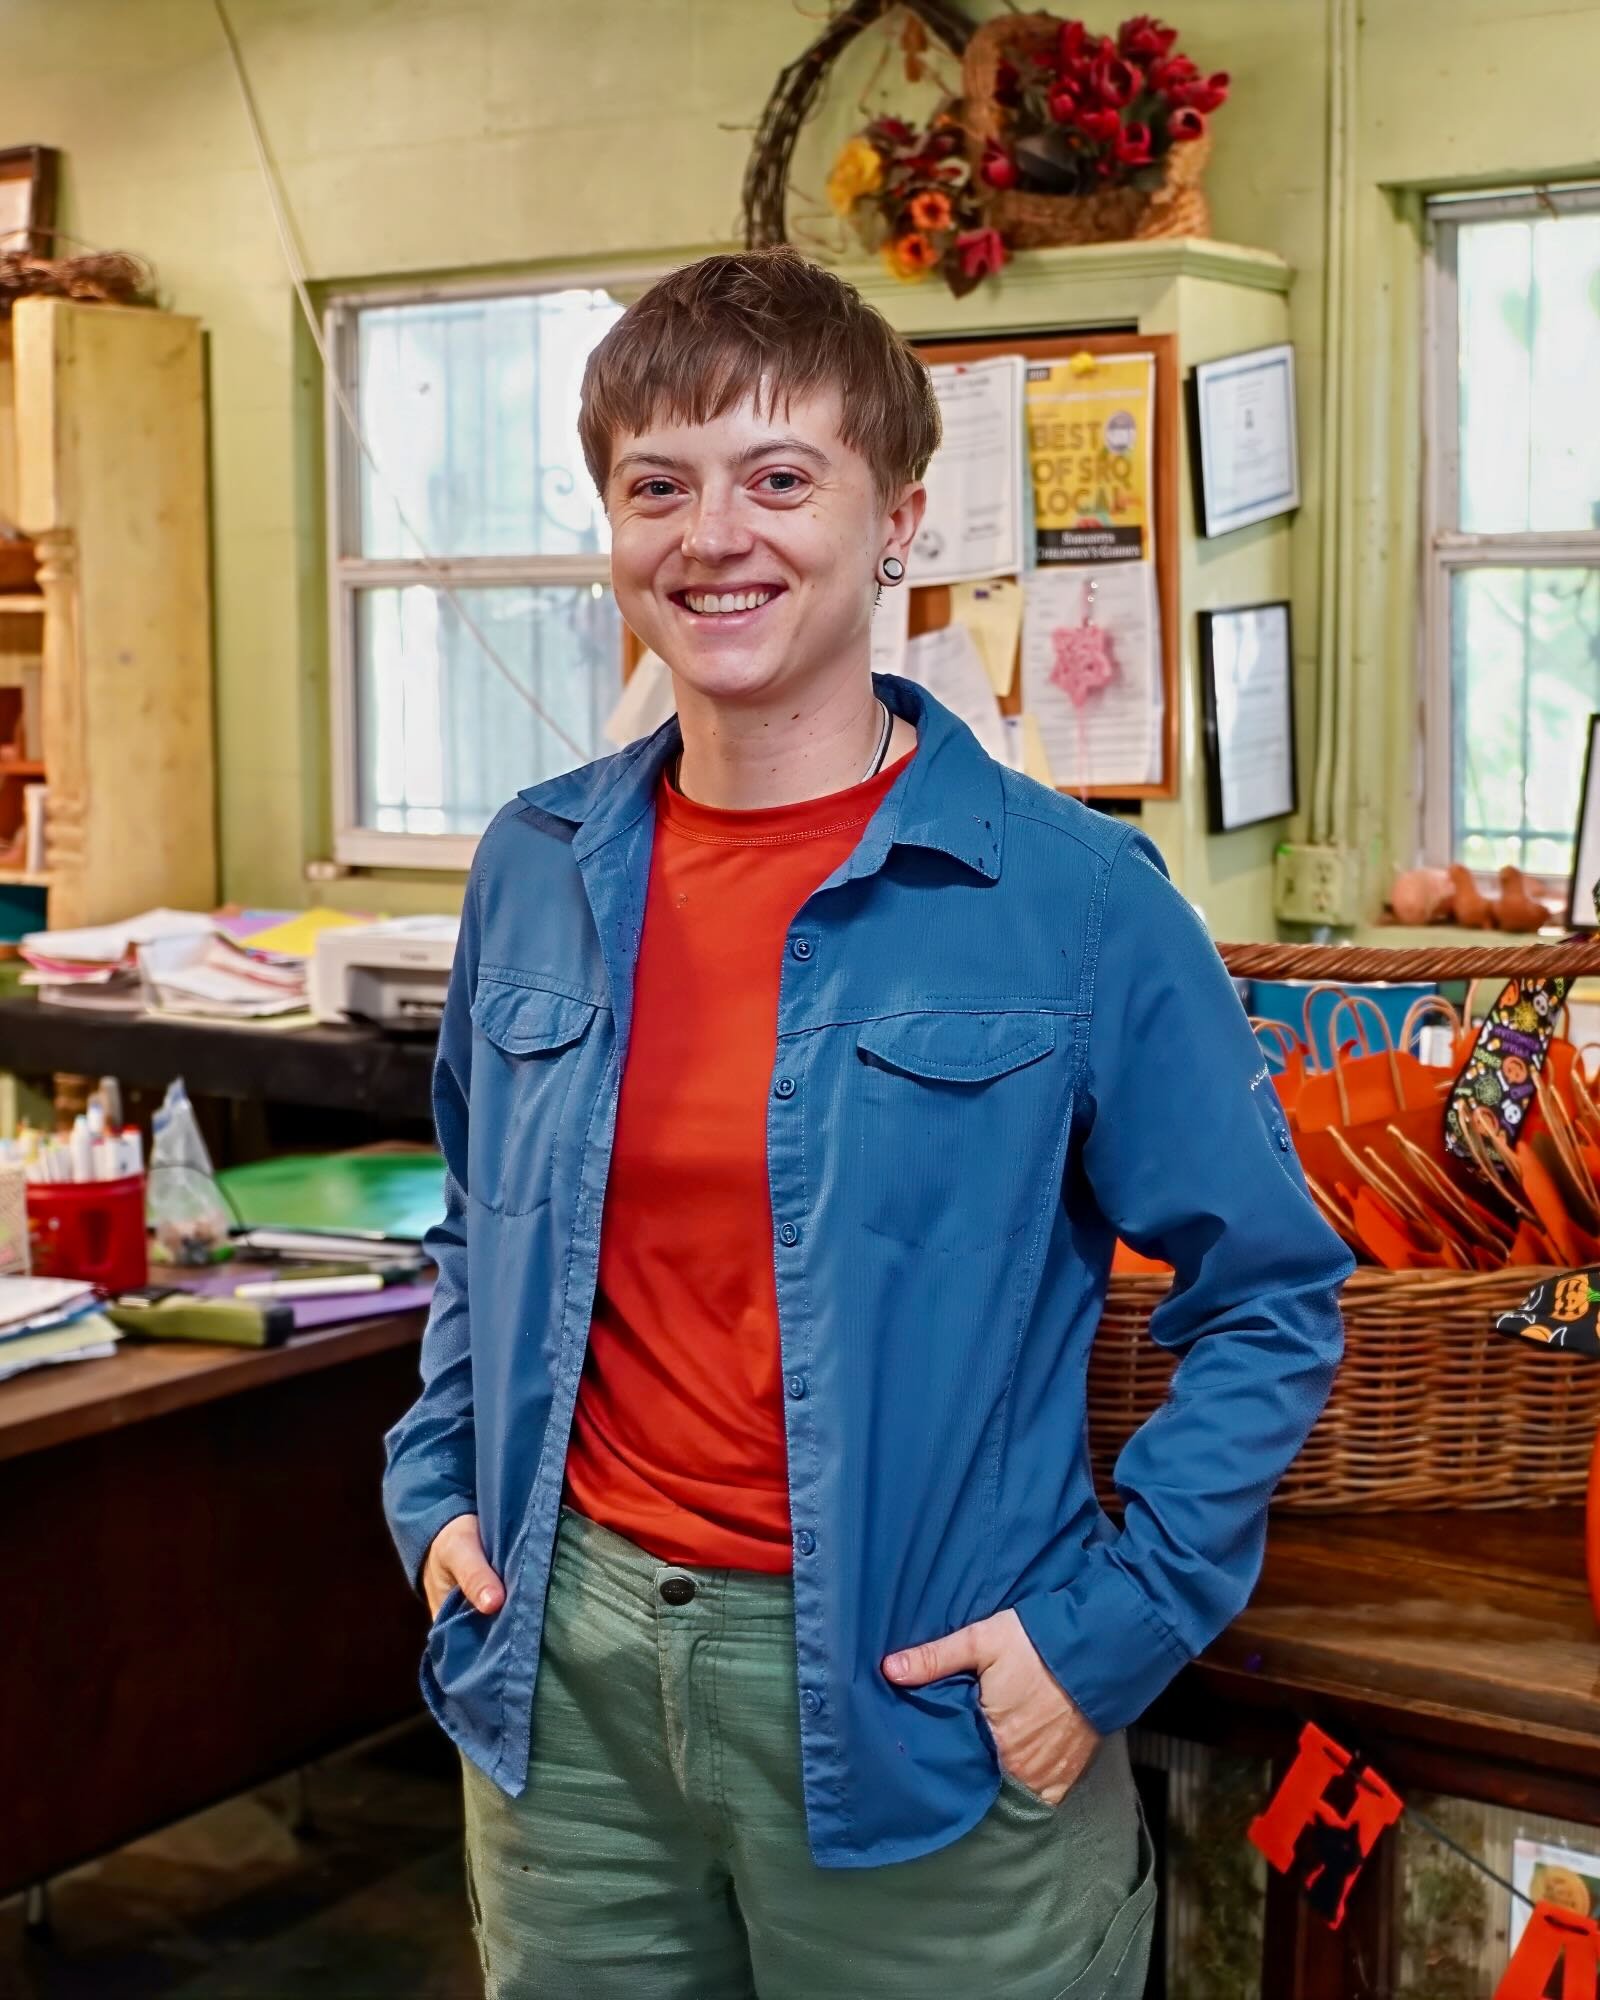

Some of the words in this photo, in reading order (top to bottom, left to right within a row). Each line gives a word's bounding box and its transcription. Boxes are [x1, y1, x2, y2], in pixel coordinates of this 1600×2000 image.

[1031, 420, 1102, 451] BEST
[1032, 457, 1073, 486] OF
[1078, 455, 1132, 490] SRQ
[1033, 486, 1127, 518] LOCAL
